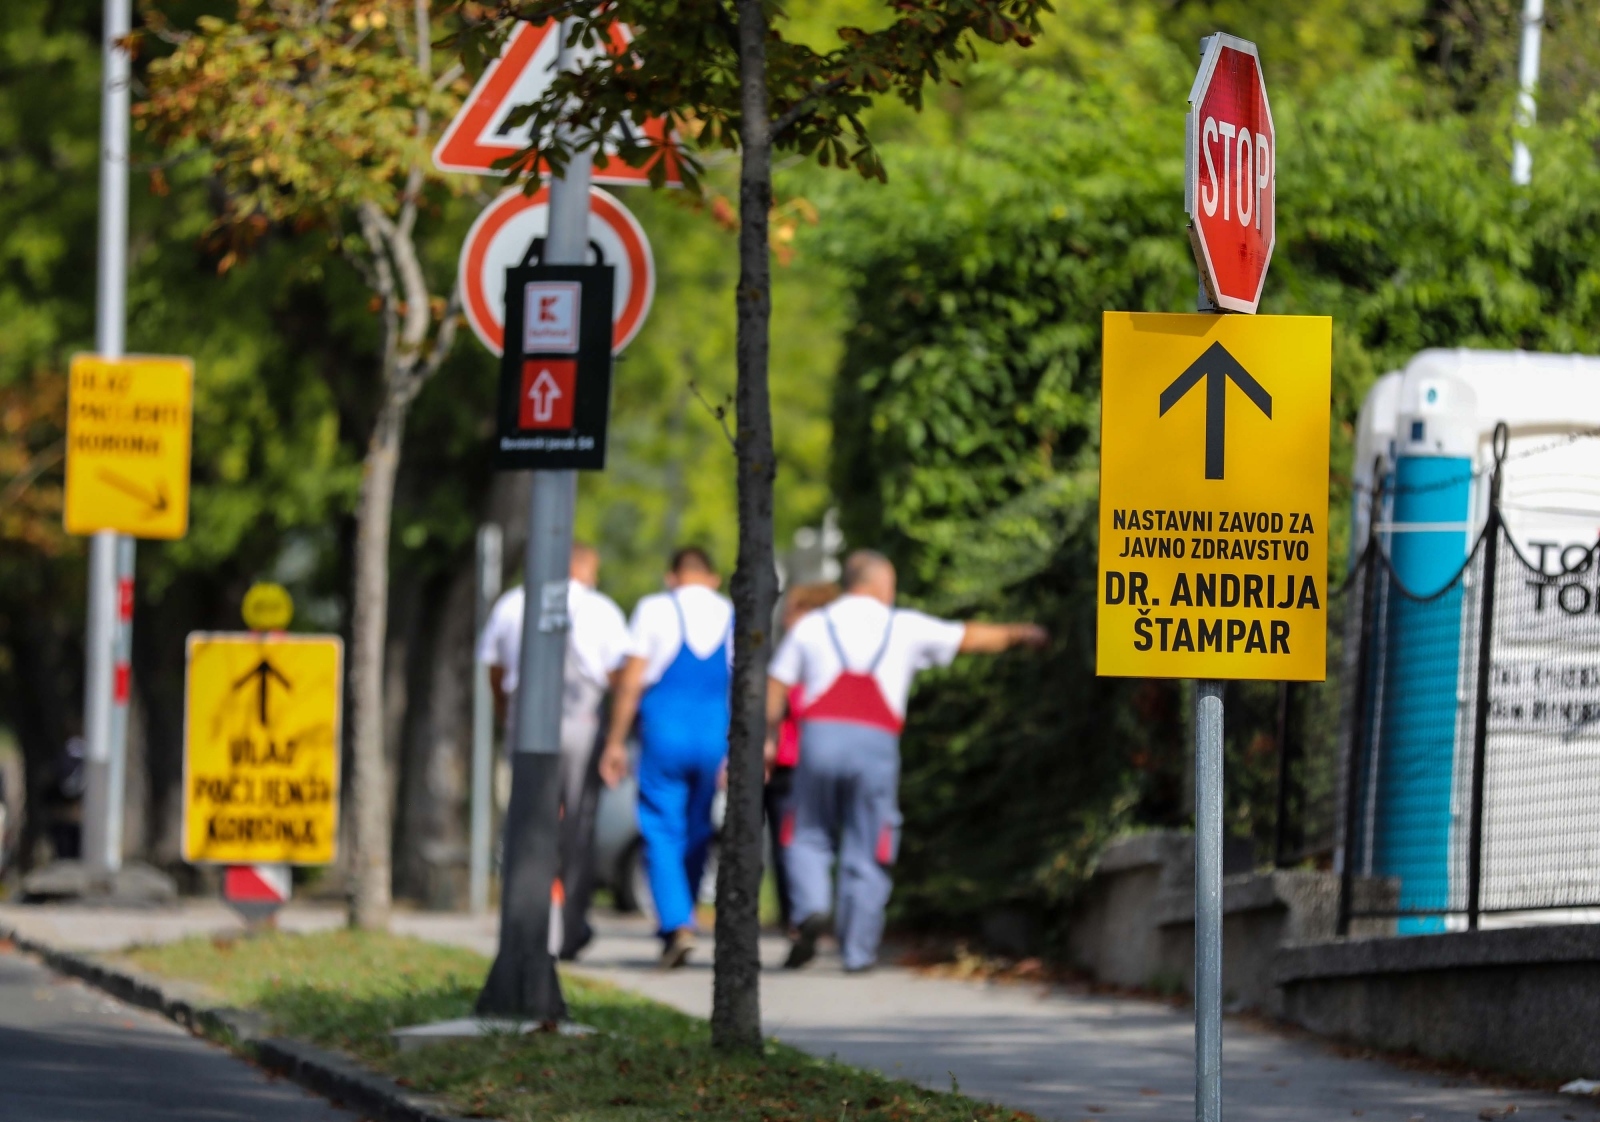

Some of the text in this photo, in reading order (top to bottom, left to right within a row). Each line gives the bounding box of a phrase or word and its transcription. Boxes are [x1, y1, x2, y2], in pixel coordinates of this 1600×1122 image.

[1201, 116, 1270, 230] STOP
[1113, 509, 1315, 534] NASTAVNI ZAVOD ZA
[1119, 536, 1309, 562] JAVNO ZDRAVSTVO
[1105, 571, 1320, 610] DR. ANDRIJA
[1133, 608, 1291, 654] ŠTAMPAR
